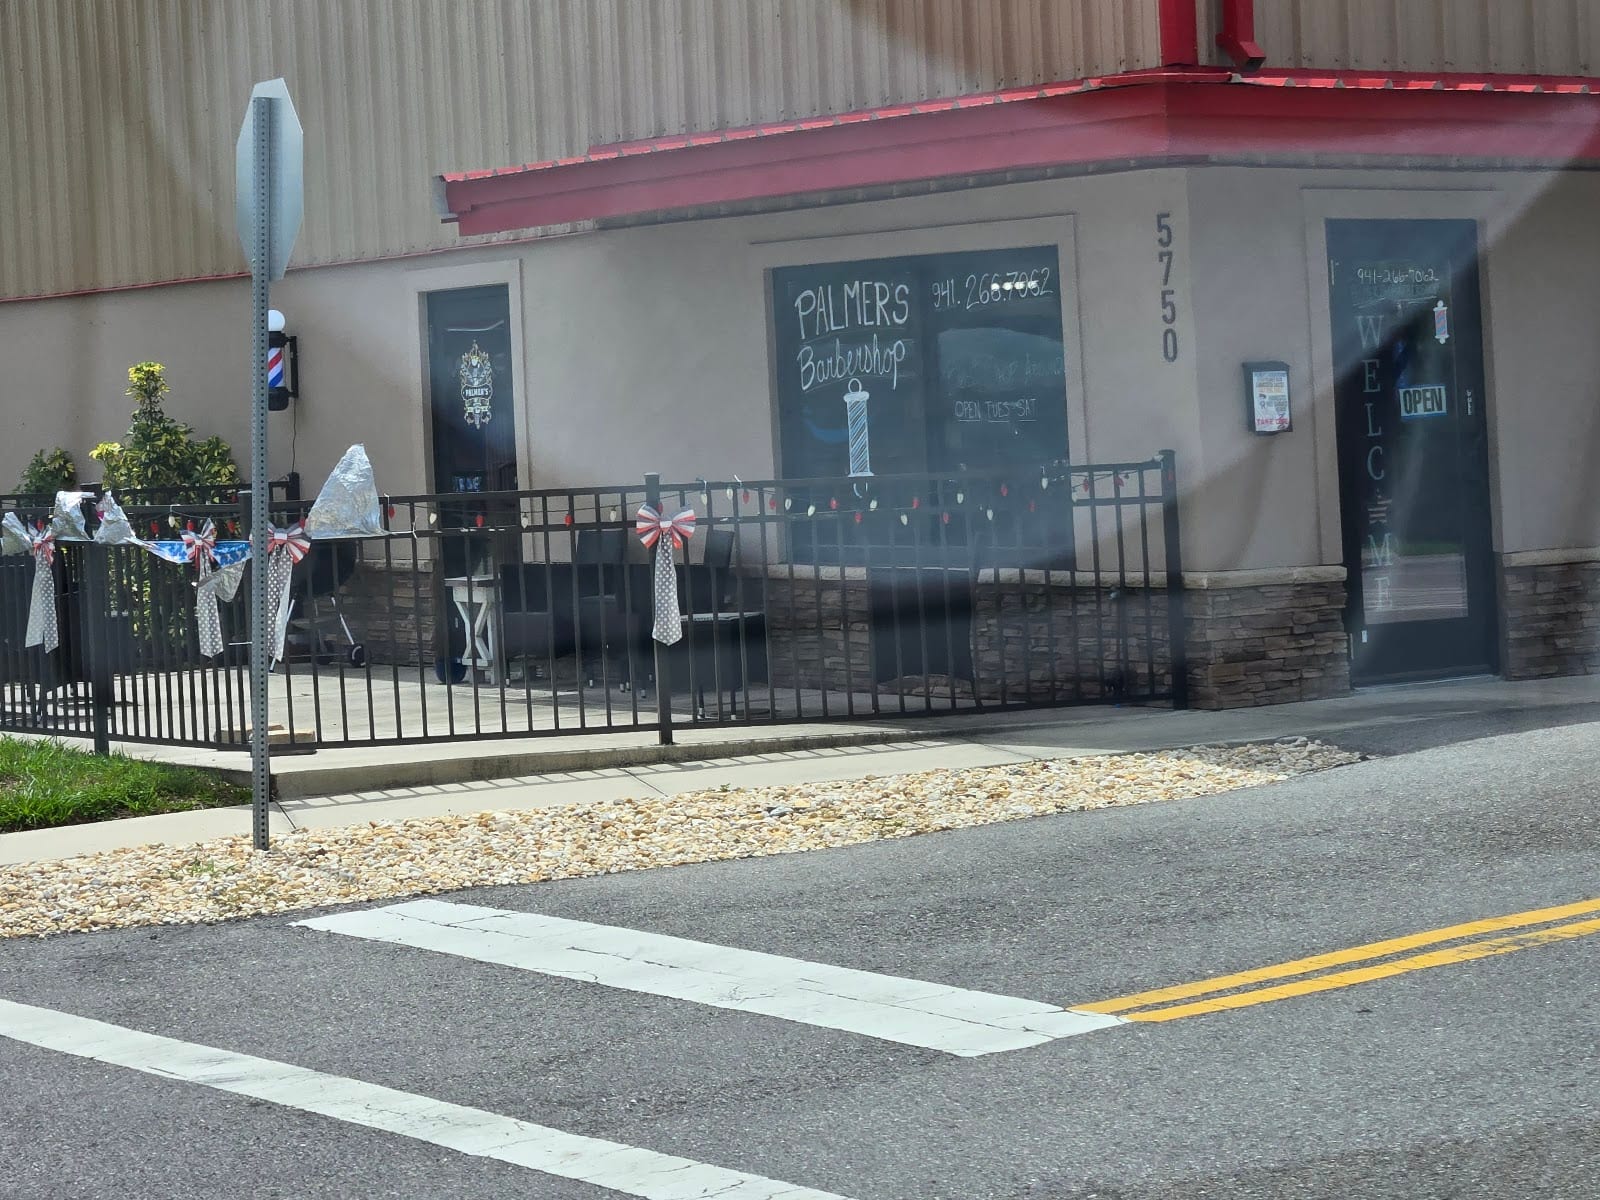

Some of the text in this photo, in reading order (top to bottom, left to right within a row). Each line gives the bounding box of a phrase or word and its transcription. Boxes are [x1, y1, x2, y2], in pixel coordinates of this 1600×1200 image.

[794, 280, 910, 340] PALMER'S
[1156, 212, 1178, 363] 5750
[796, 333, 906, 392] Barbershop
[954, 400, 982, 419] OPEN
[1403, 387, 1443, 414] OPEN
